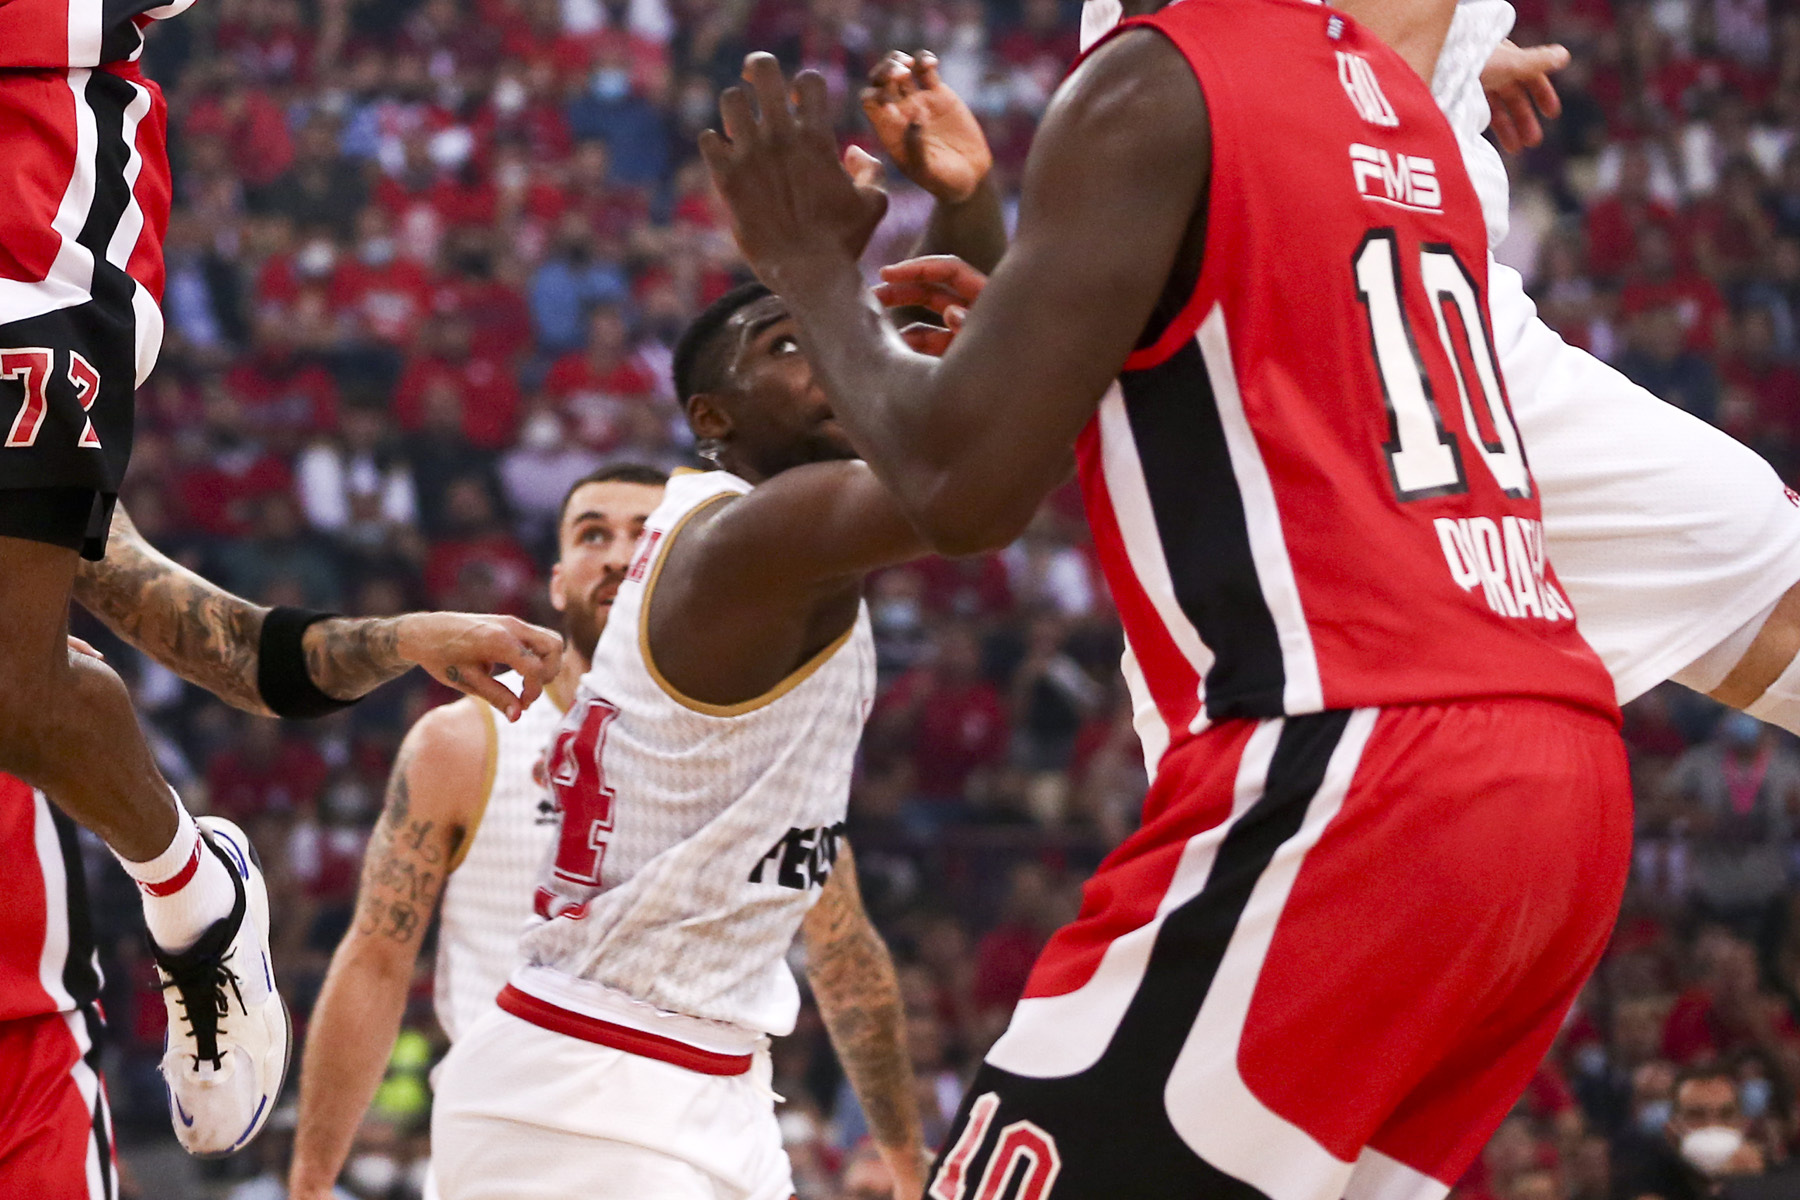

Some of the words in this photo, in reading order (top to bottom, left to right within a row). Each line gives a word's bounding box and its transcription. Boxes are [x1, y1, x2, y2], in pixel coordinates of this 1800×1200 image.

[1348, 143, 1443, 207] FMS
[1351, 224, 1534, 505] 10
[928, 1091, 1063, 1200] 10
